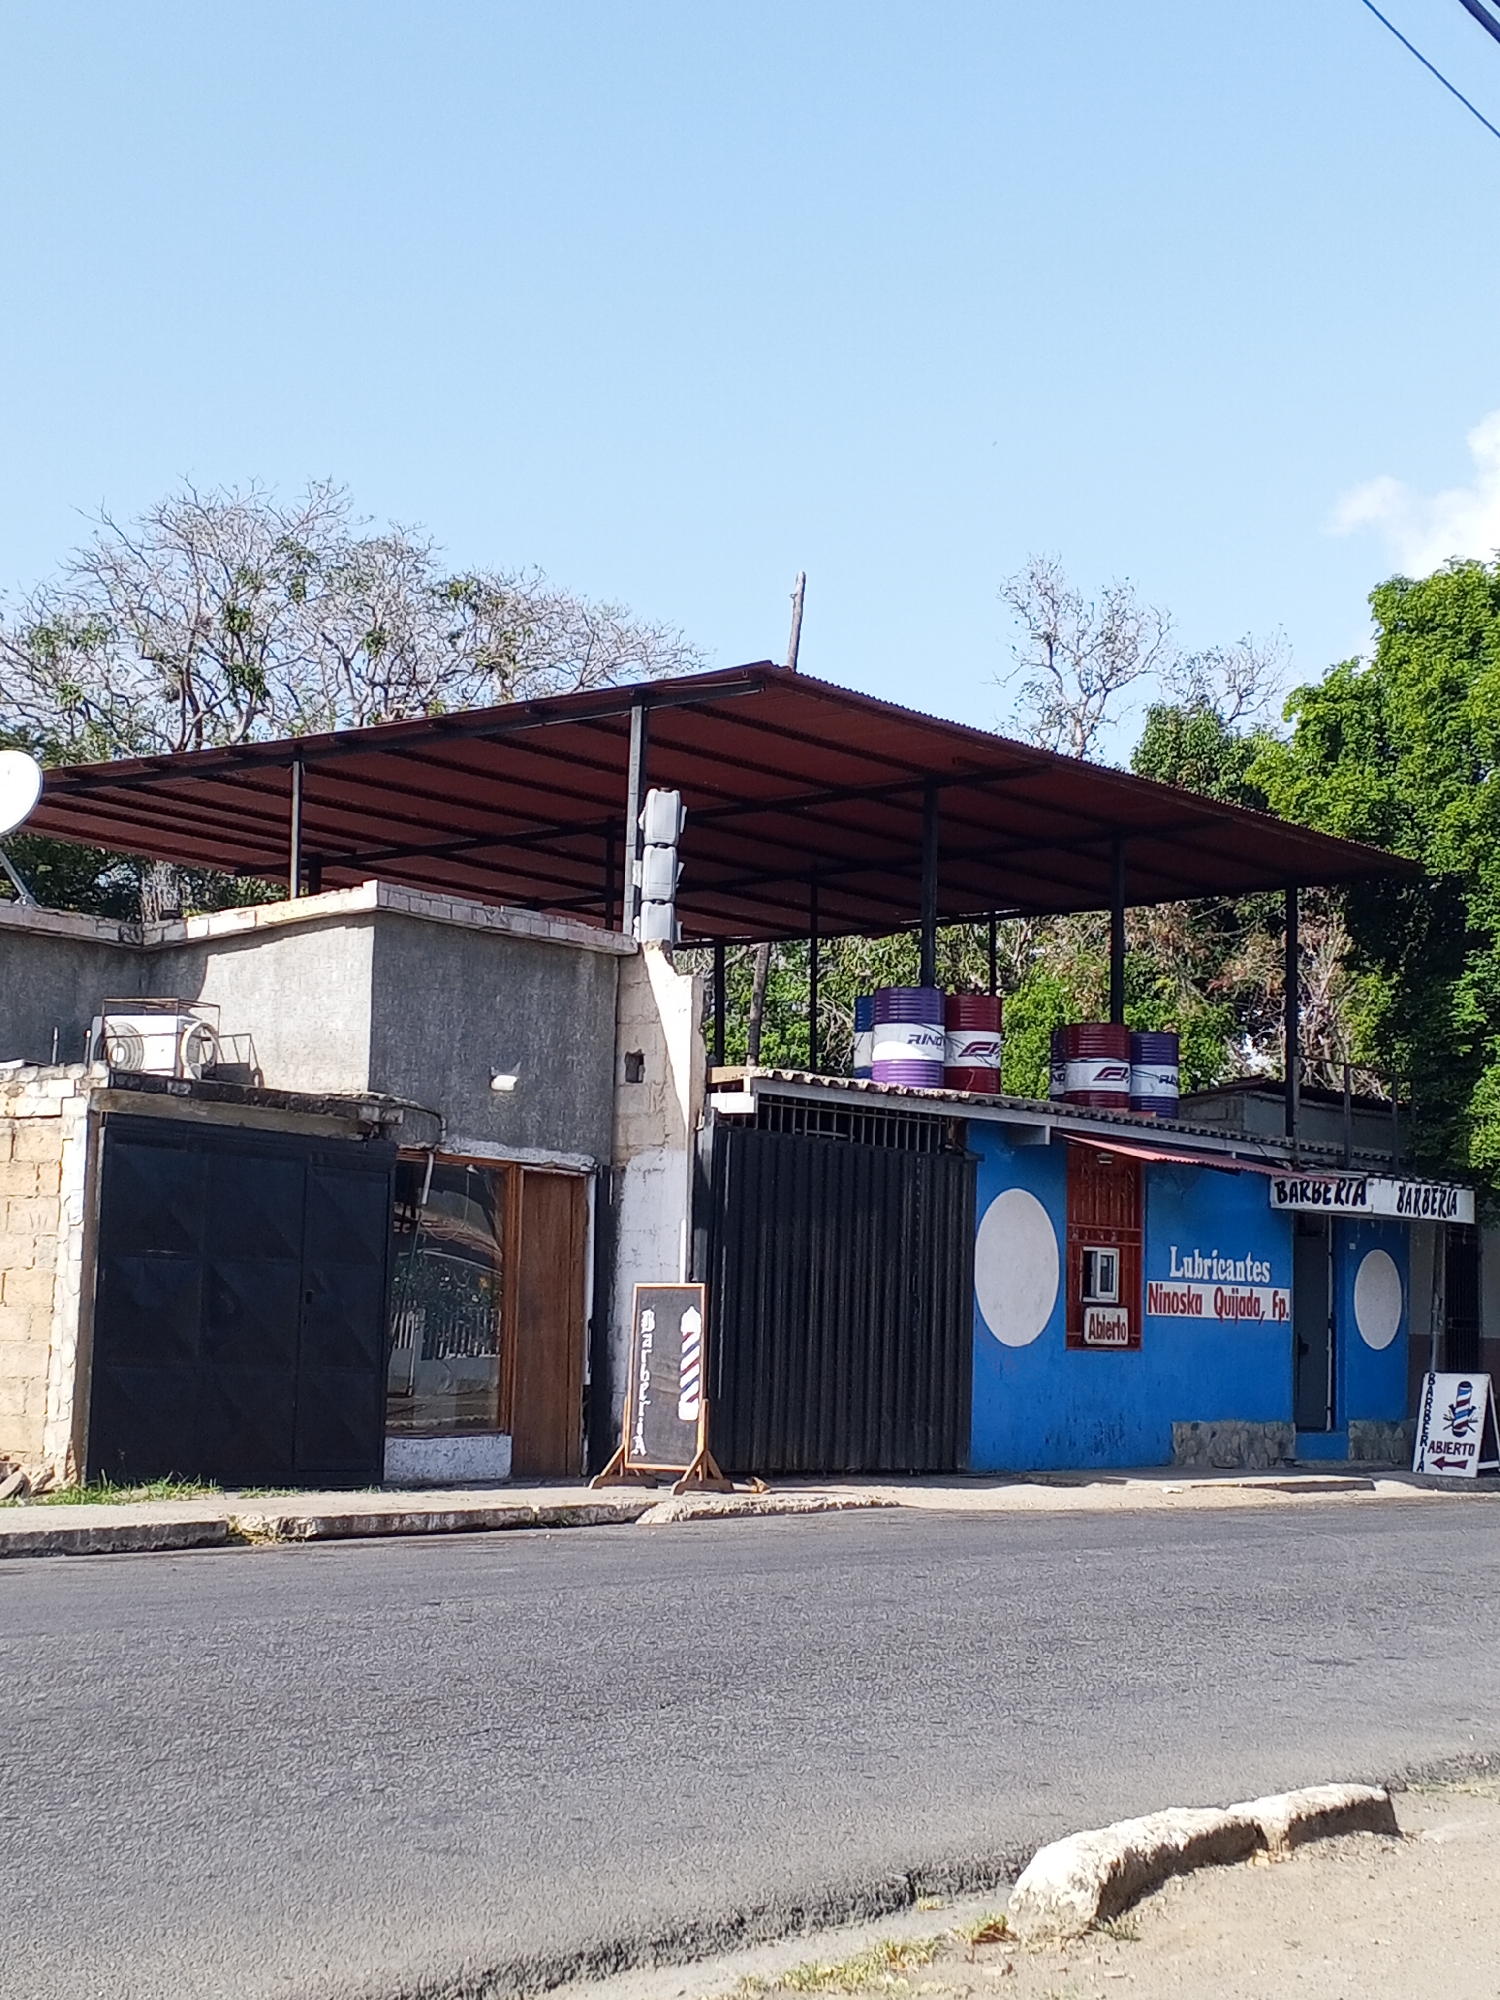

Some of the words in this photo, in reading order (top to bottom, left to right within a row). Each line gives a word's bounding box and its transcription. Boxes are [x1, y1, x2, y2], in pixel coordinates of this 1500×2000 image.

[1274, 1178, 1367, 1207] BARBERIA
[1396, 1185, 1459, 1218] BARBERIA
[1169, 1246, 1271, 1283] Lubricantes
[1148, 1282, 1203, 1315] Ninoska
[1213, 1286, 1266, 1325] Quijada,
[1088, 1312, 1127, 1341] Abierto
[1416, 1373, 1436, 1472] BARBERIA
[1427, 1440, 1476, 1457] ABIERTO
